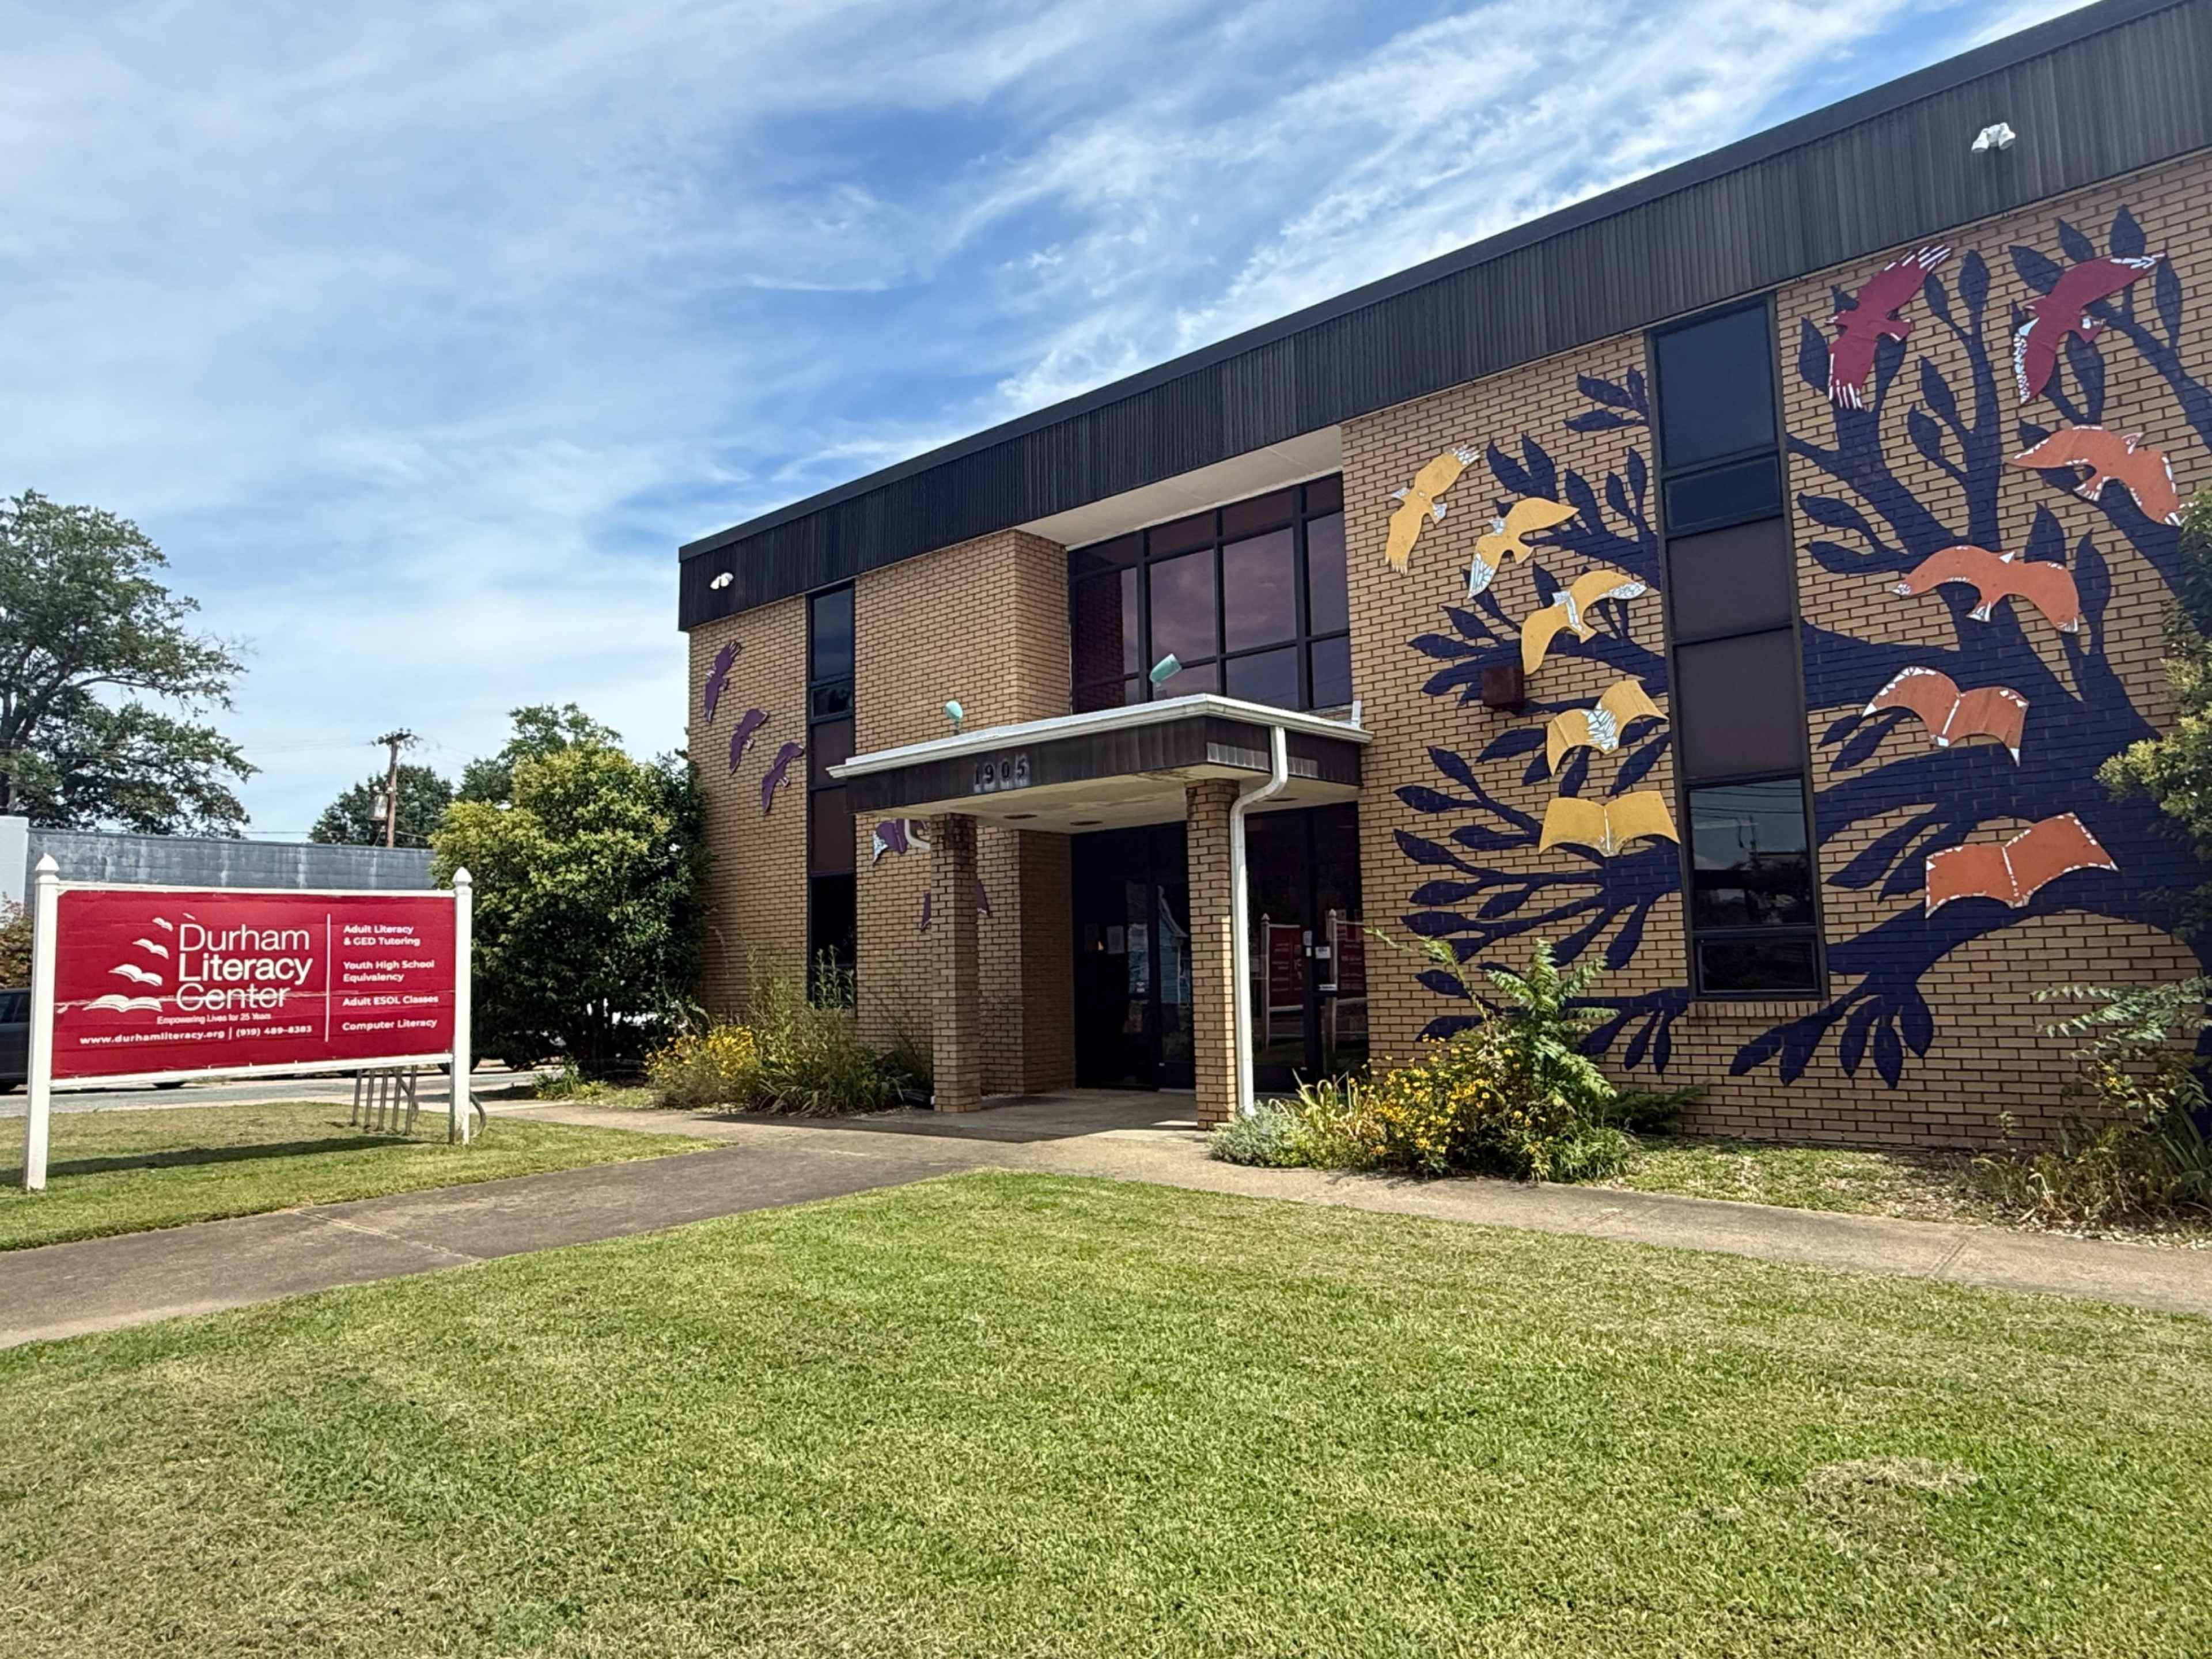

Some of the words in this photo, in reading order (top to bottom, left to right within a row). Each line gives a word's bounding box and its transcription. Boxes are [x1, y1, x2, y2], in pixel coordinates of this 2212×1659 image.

[974, 757, 1025, 784] 1905
[343, 925, 372, 933] Adult
[374, 925, 414, 934] Literacy
[180, 924, 310, 951] Durham
[343, 937, 351, 945] &
[353, 937, 376, 945] GED
[378, 937, 421, 946] Tutoring
[179, 953, 313, 985] Literacy
[343, 961, 373, 969] Youth
[376, 960, 399, 971] High
[402, 960, 434, 968] School
[343, 973, 404, 983] Equivalency
[176, 983, 290, 1011] Center
[343, 997, 372, 1006] Adult
[374, 996, 400, 1005] ESOL
[403, 995, 438, 1003] Classes
[157, 1016, 205, 1025] Empowering
[240, 1013, 250, 1021] 25
[342, 1021, 395, 1031] Computer
[397, 1019, 437, 1028] Literacy
[79, 1031, 225, 1044] www.durhamliteracy.org
[236, 1028, 260, 1038] (919)
[264, 1025, 312, 1035] 489-8383
